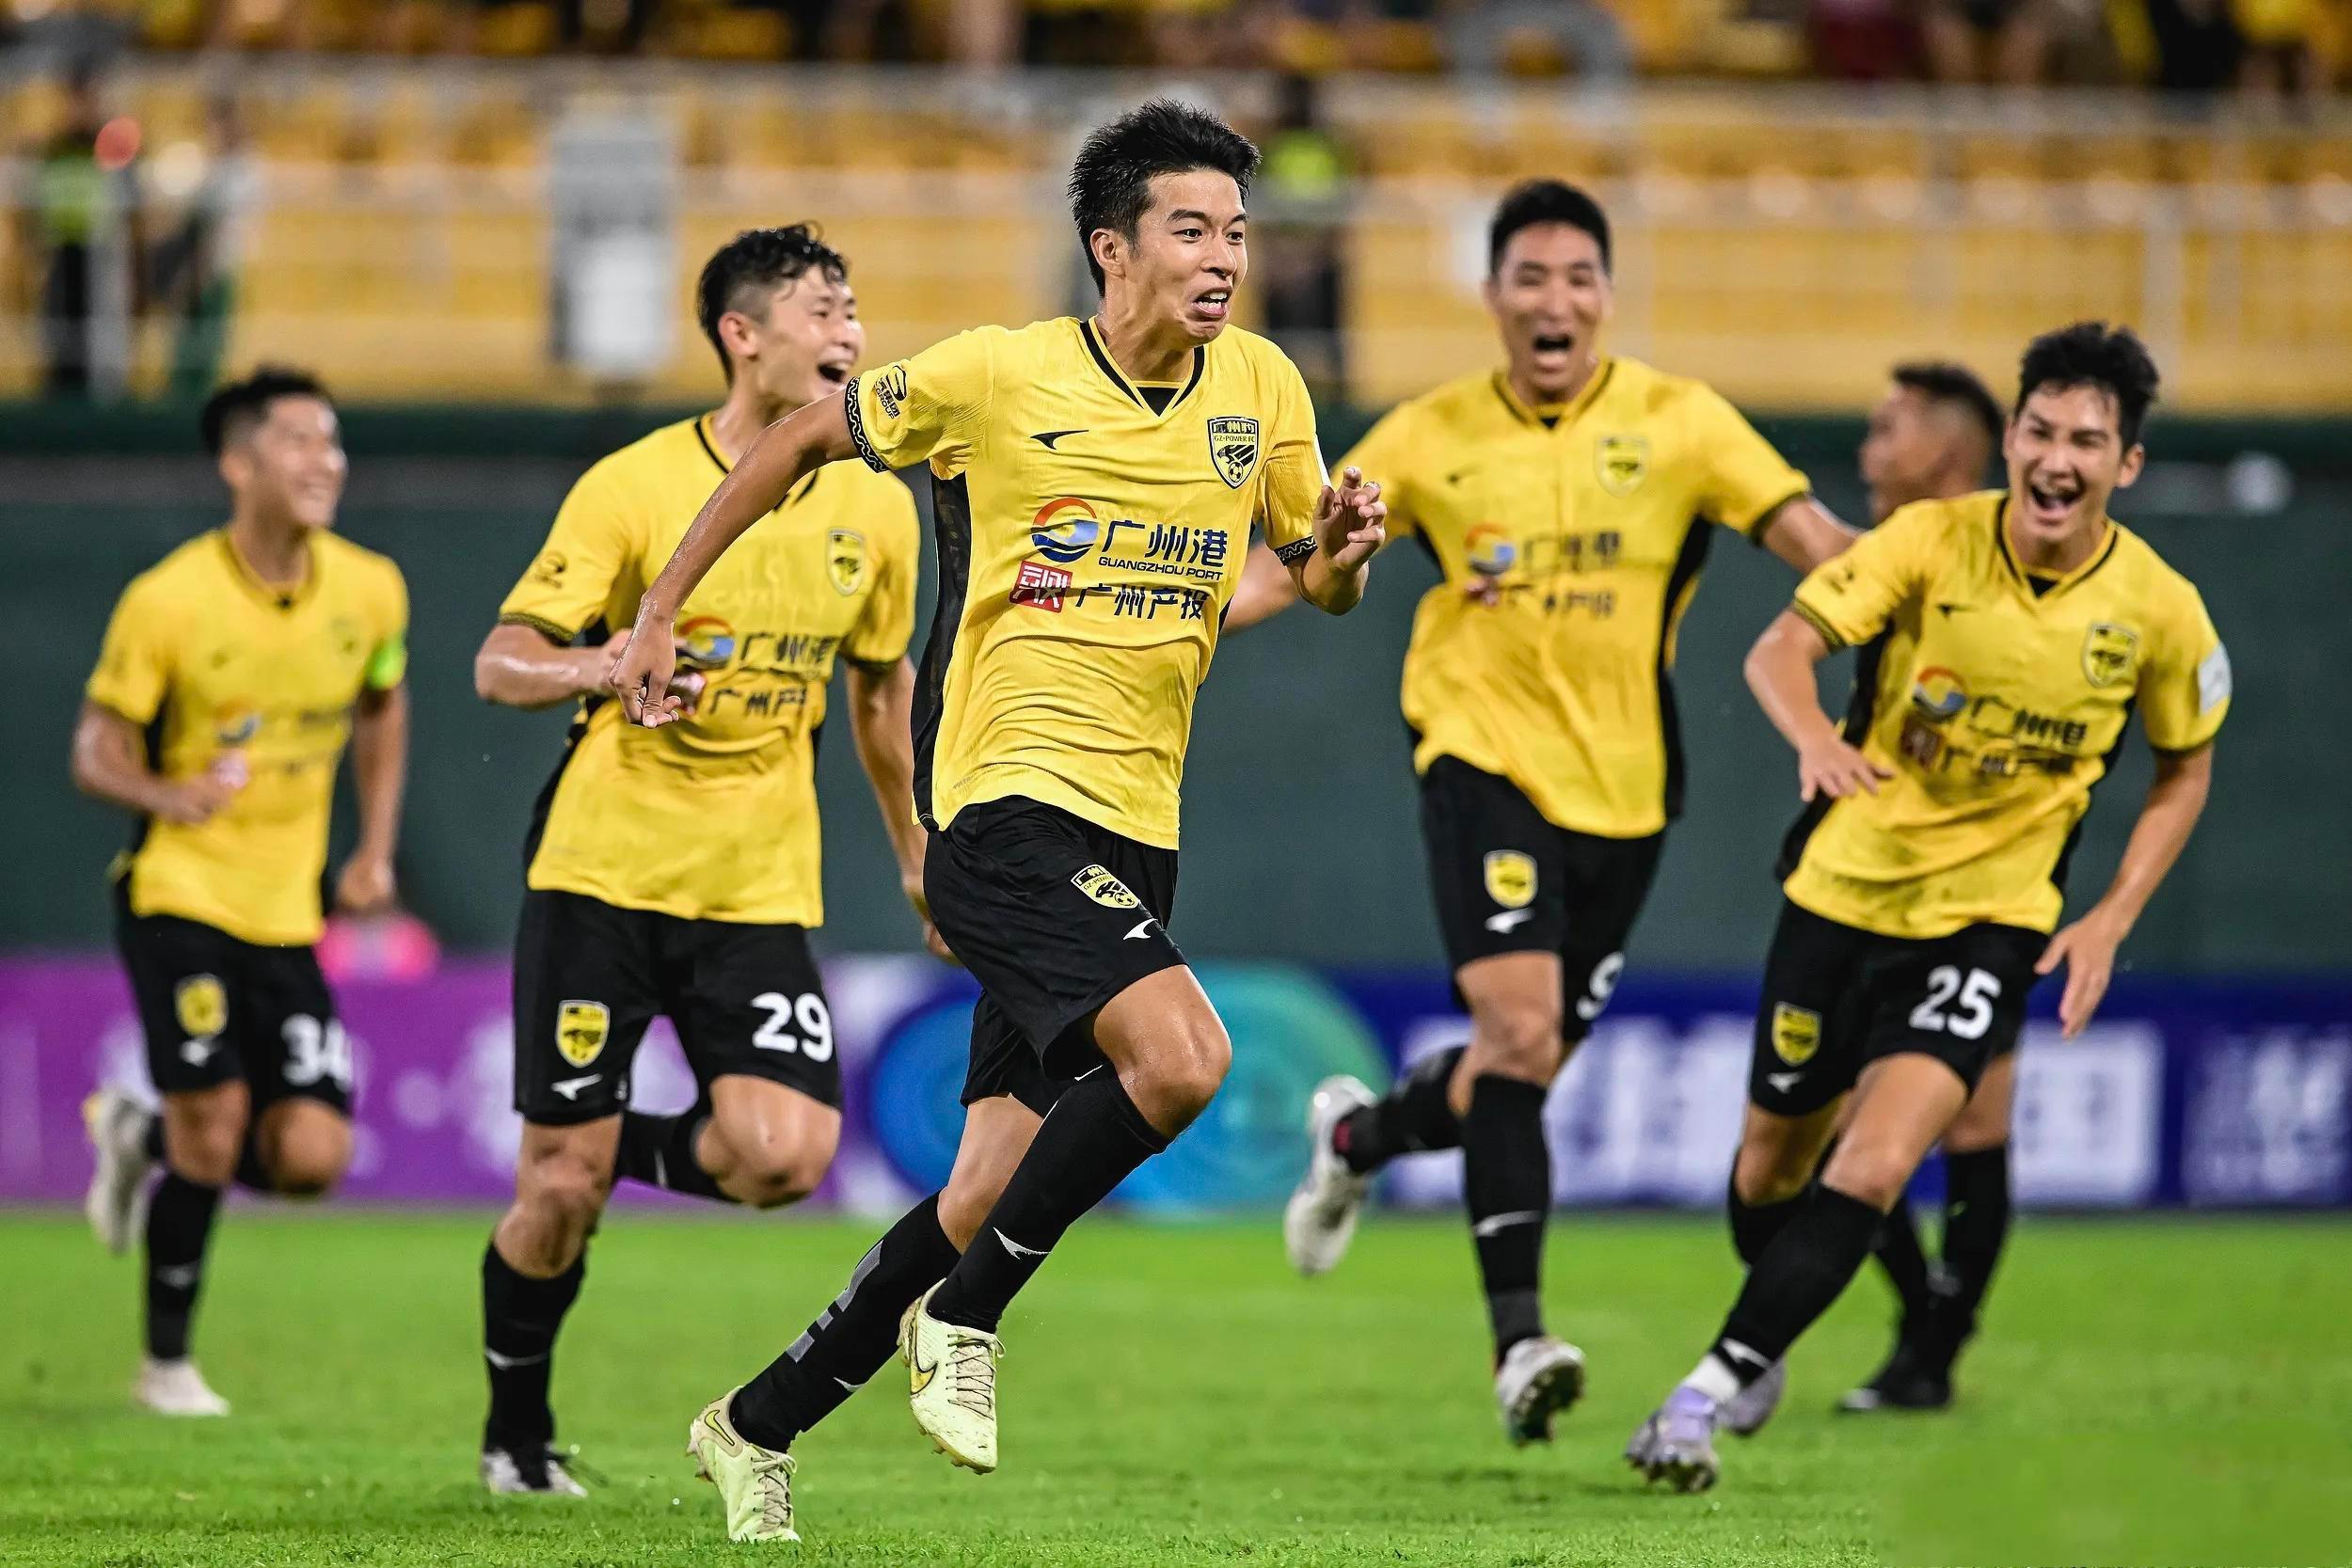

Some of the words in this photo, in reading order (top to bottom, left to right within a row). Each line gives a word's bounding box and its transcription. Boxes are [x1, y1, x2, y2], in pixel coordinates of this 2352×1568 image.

[1098, 556, 1185, 576] GUANGZHOU
[1185, 567, 1224, 581] PORT
[1102, 520, 1228, 567] 广州港
[1075, 582, 1210, 620] 广州产投
[751, 991, 834, 1063] 29
[1908, 964, 2002, 1039] 25
[280, 1013, 353, 1092] 34
